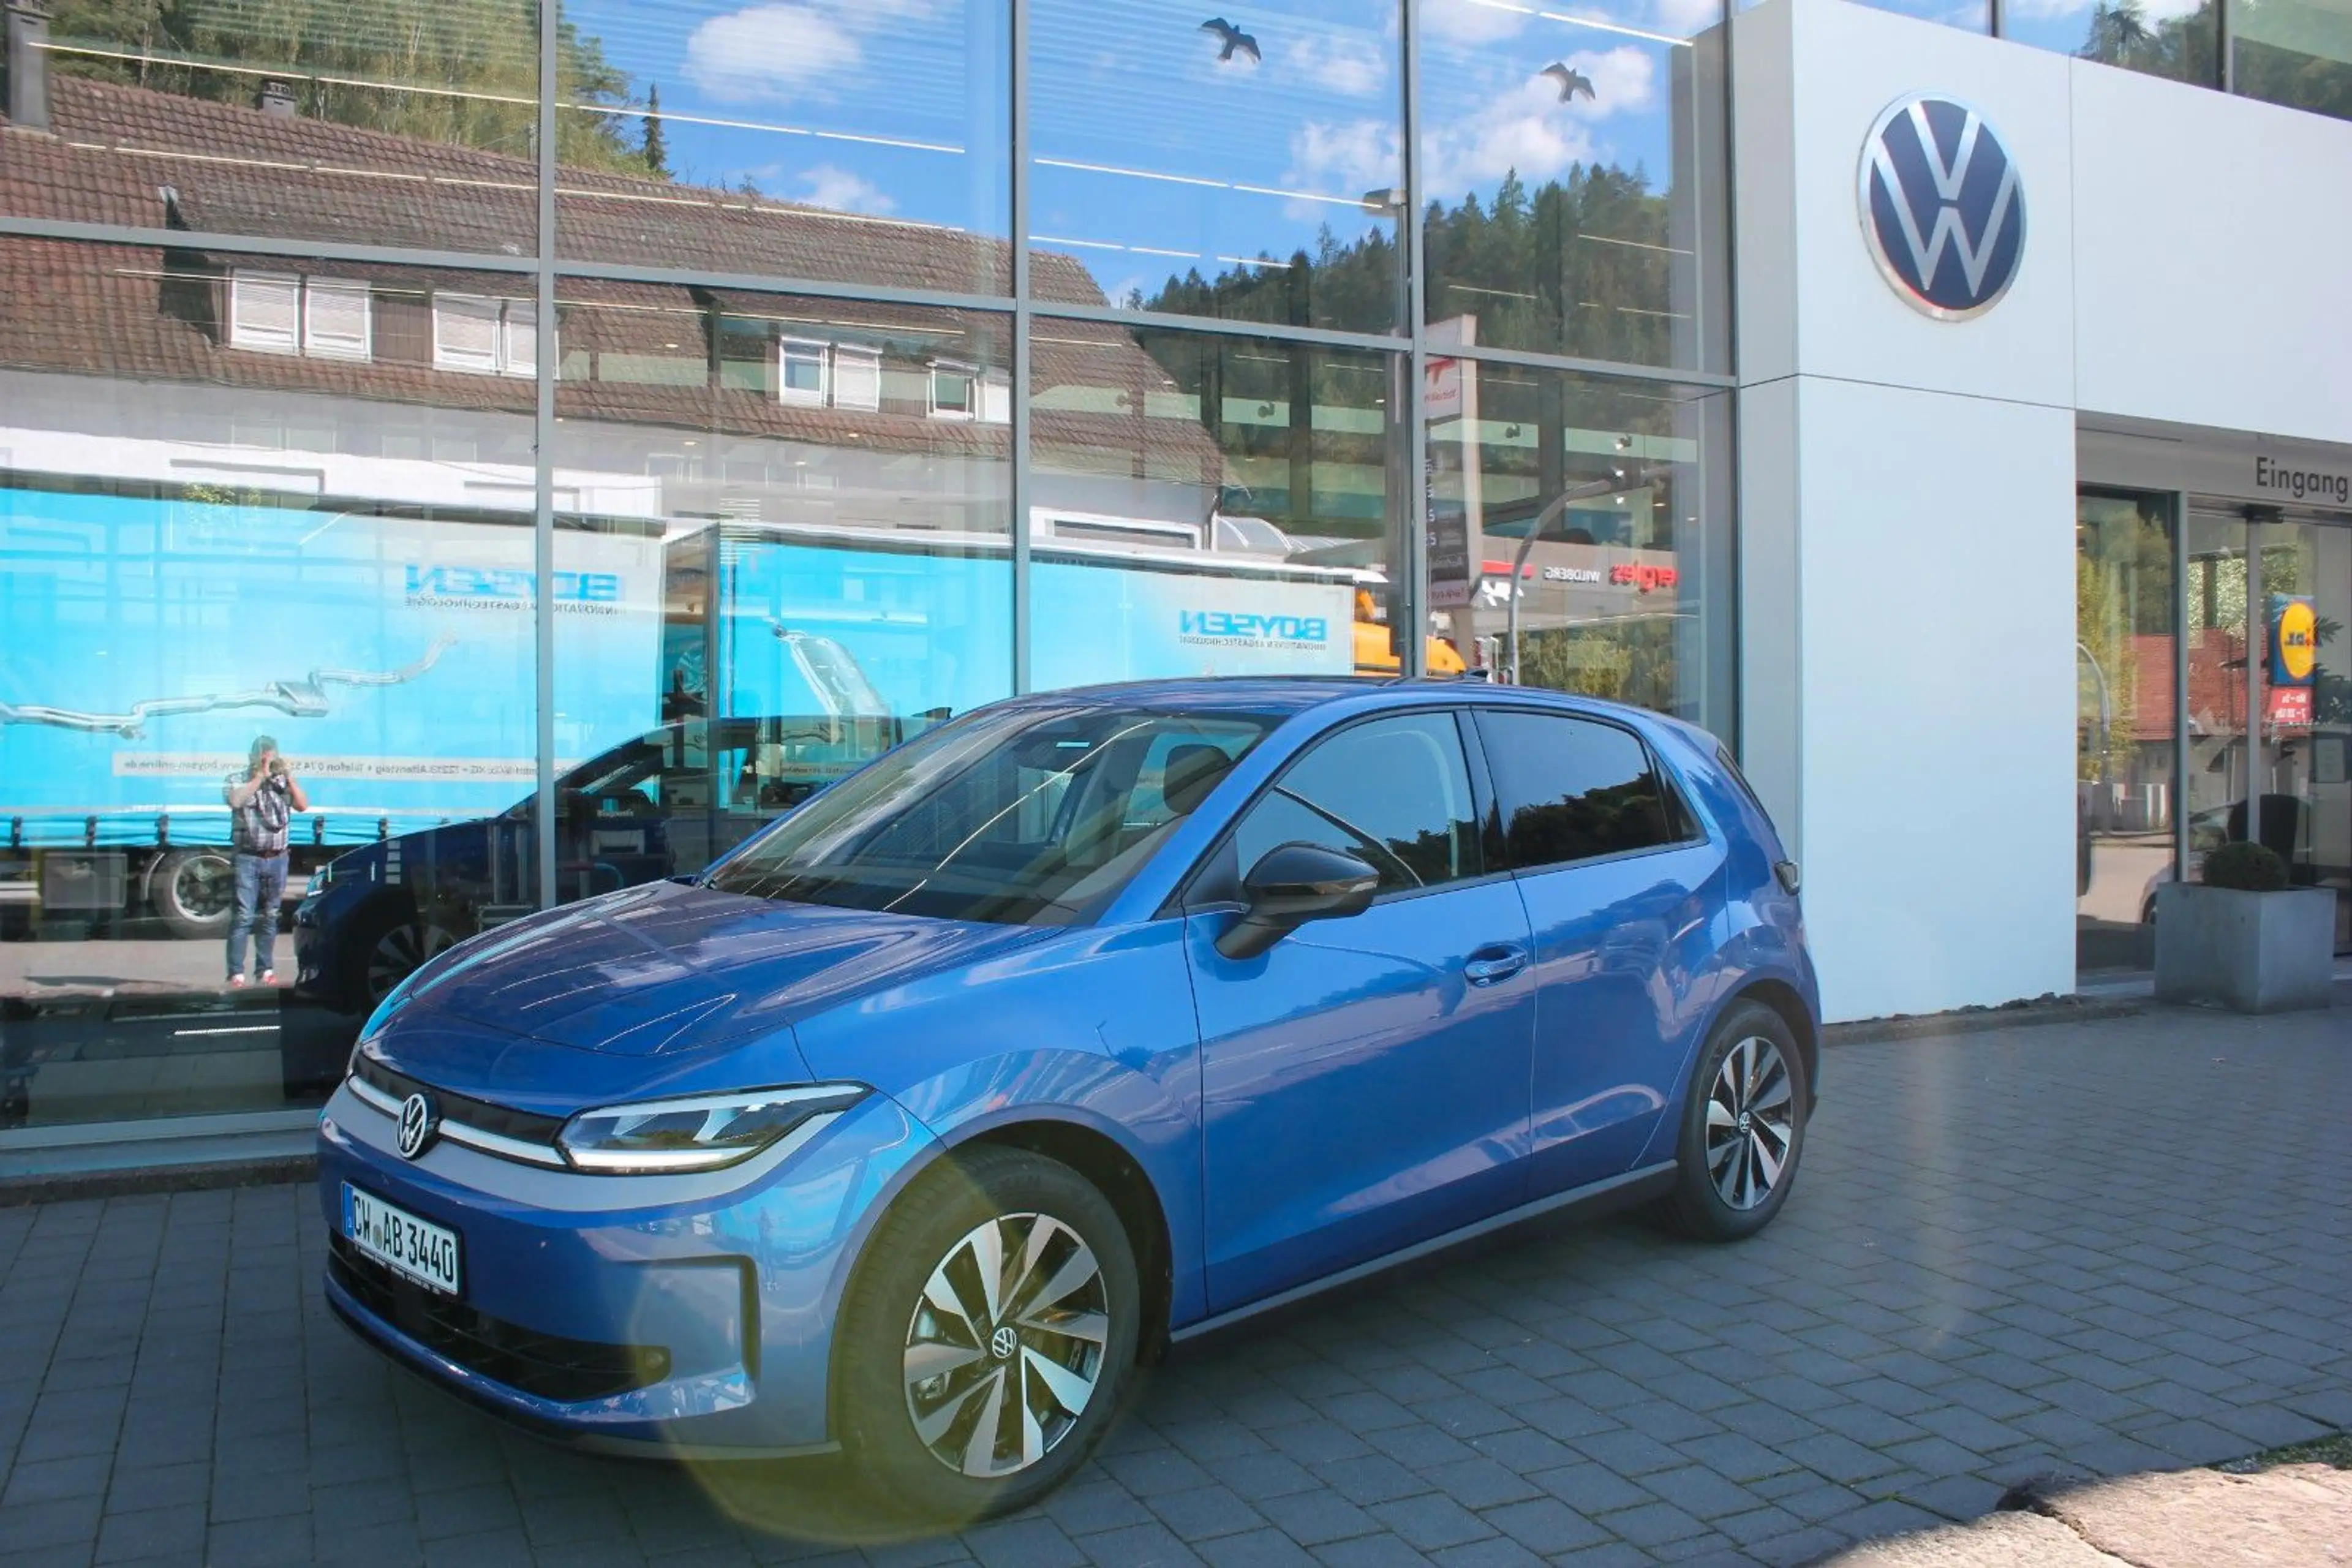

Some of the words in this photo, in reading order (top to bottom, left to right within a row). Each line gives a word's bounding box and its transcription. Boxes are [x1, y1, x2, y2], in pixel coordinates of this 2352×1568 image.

[1867, 93, 2021, 305] VW
[2256, 457, 2348, 503] Eingang
[354, 1194, 371, 1243] CW
[383, 1211, 402, 1258] AB
[407, 1222, 454, 1283] 3440
